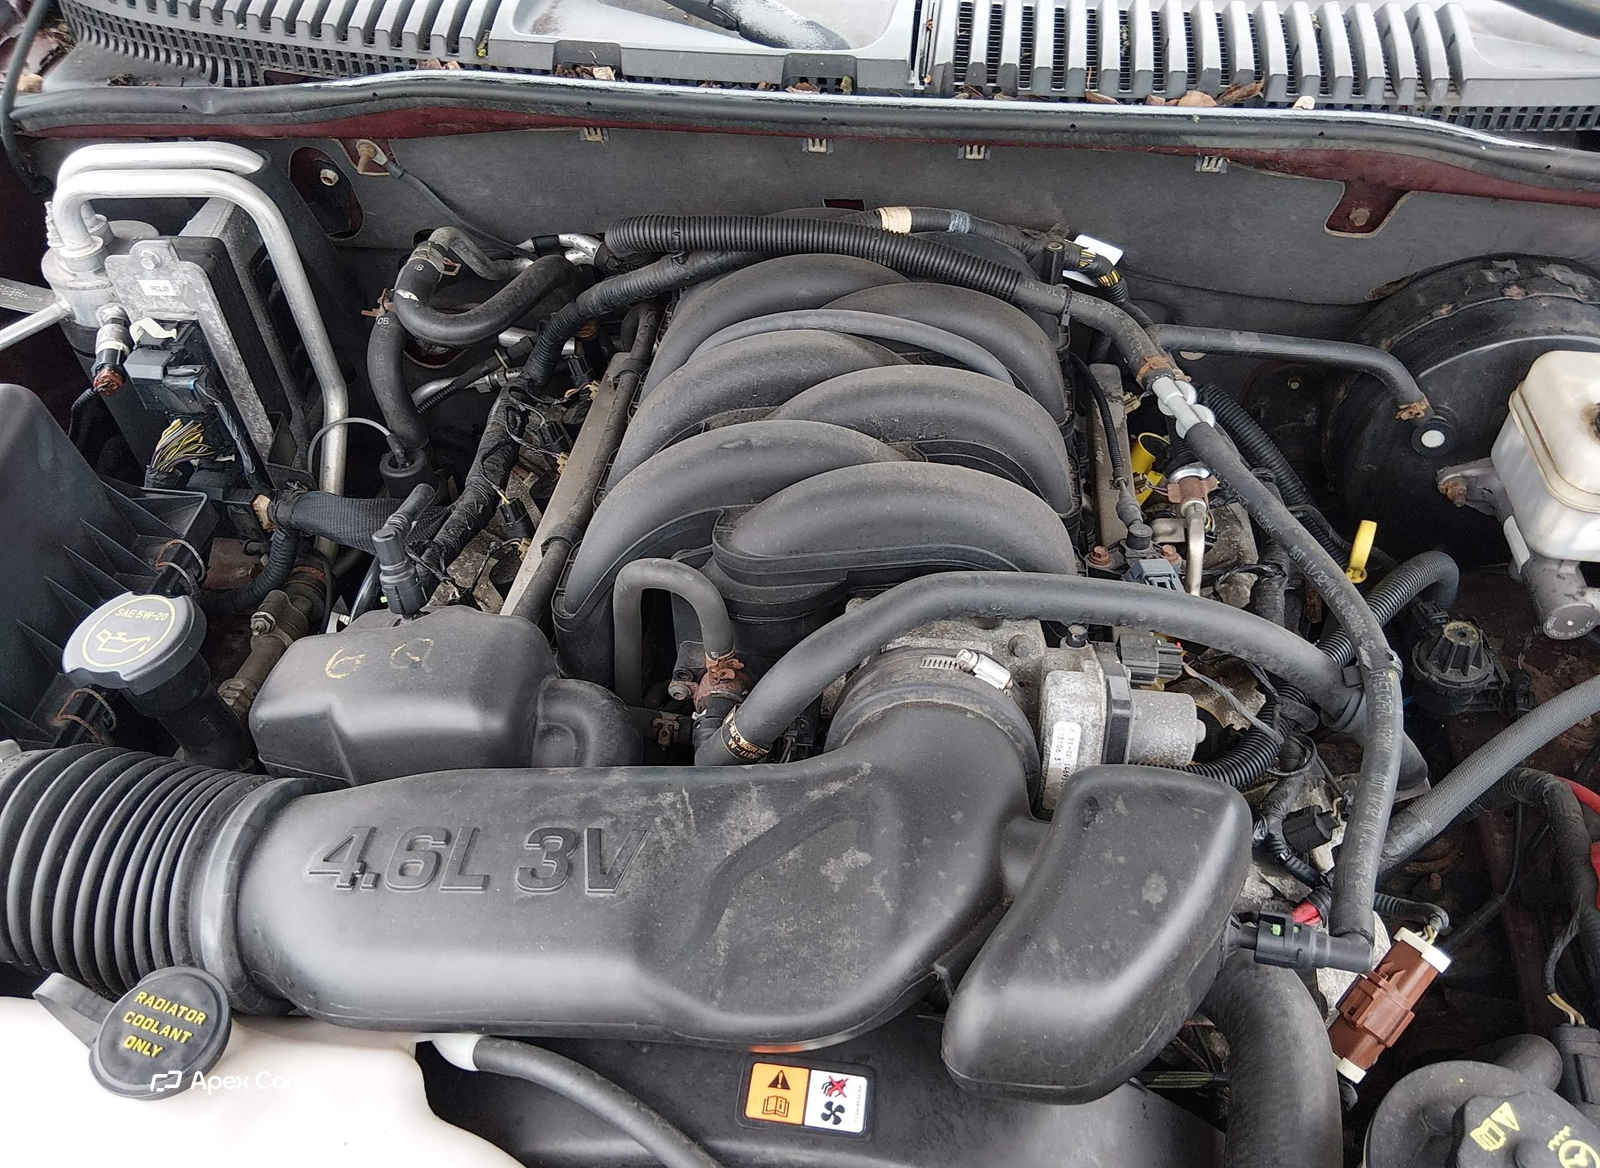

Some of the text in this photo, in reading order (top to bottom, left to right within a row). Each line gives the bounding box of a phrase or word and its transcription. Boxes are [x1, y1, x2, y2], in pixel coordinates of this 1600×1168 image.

[115, 608, 170, 621] SAE 5W-20
[308, 826, 651, 896] 4.6L 3V
[134, 991, 208, 1026] RADIATOR
[122, 1011, 194, 1044] COOLANT
[123, 1035, 164, 1058] ONLY
